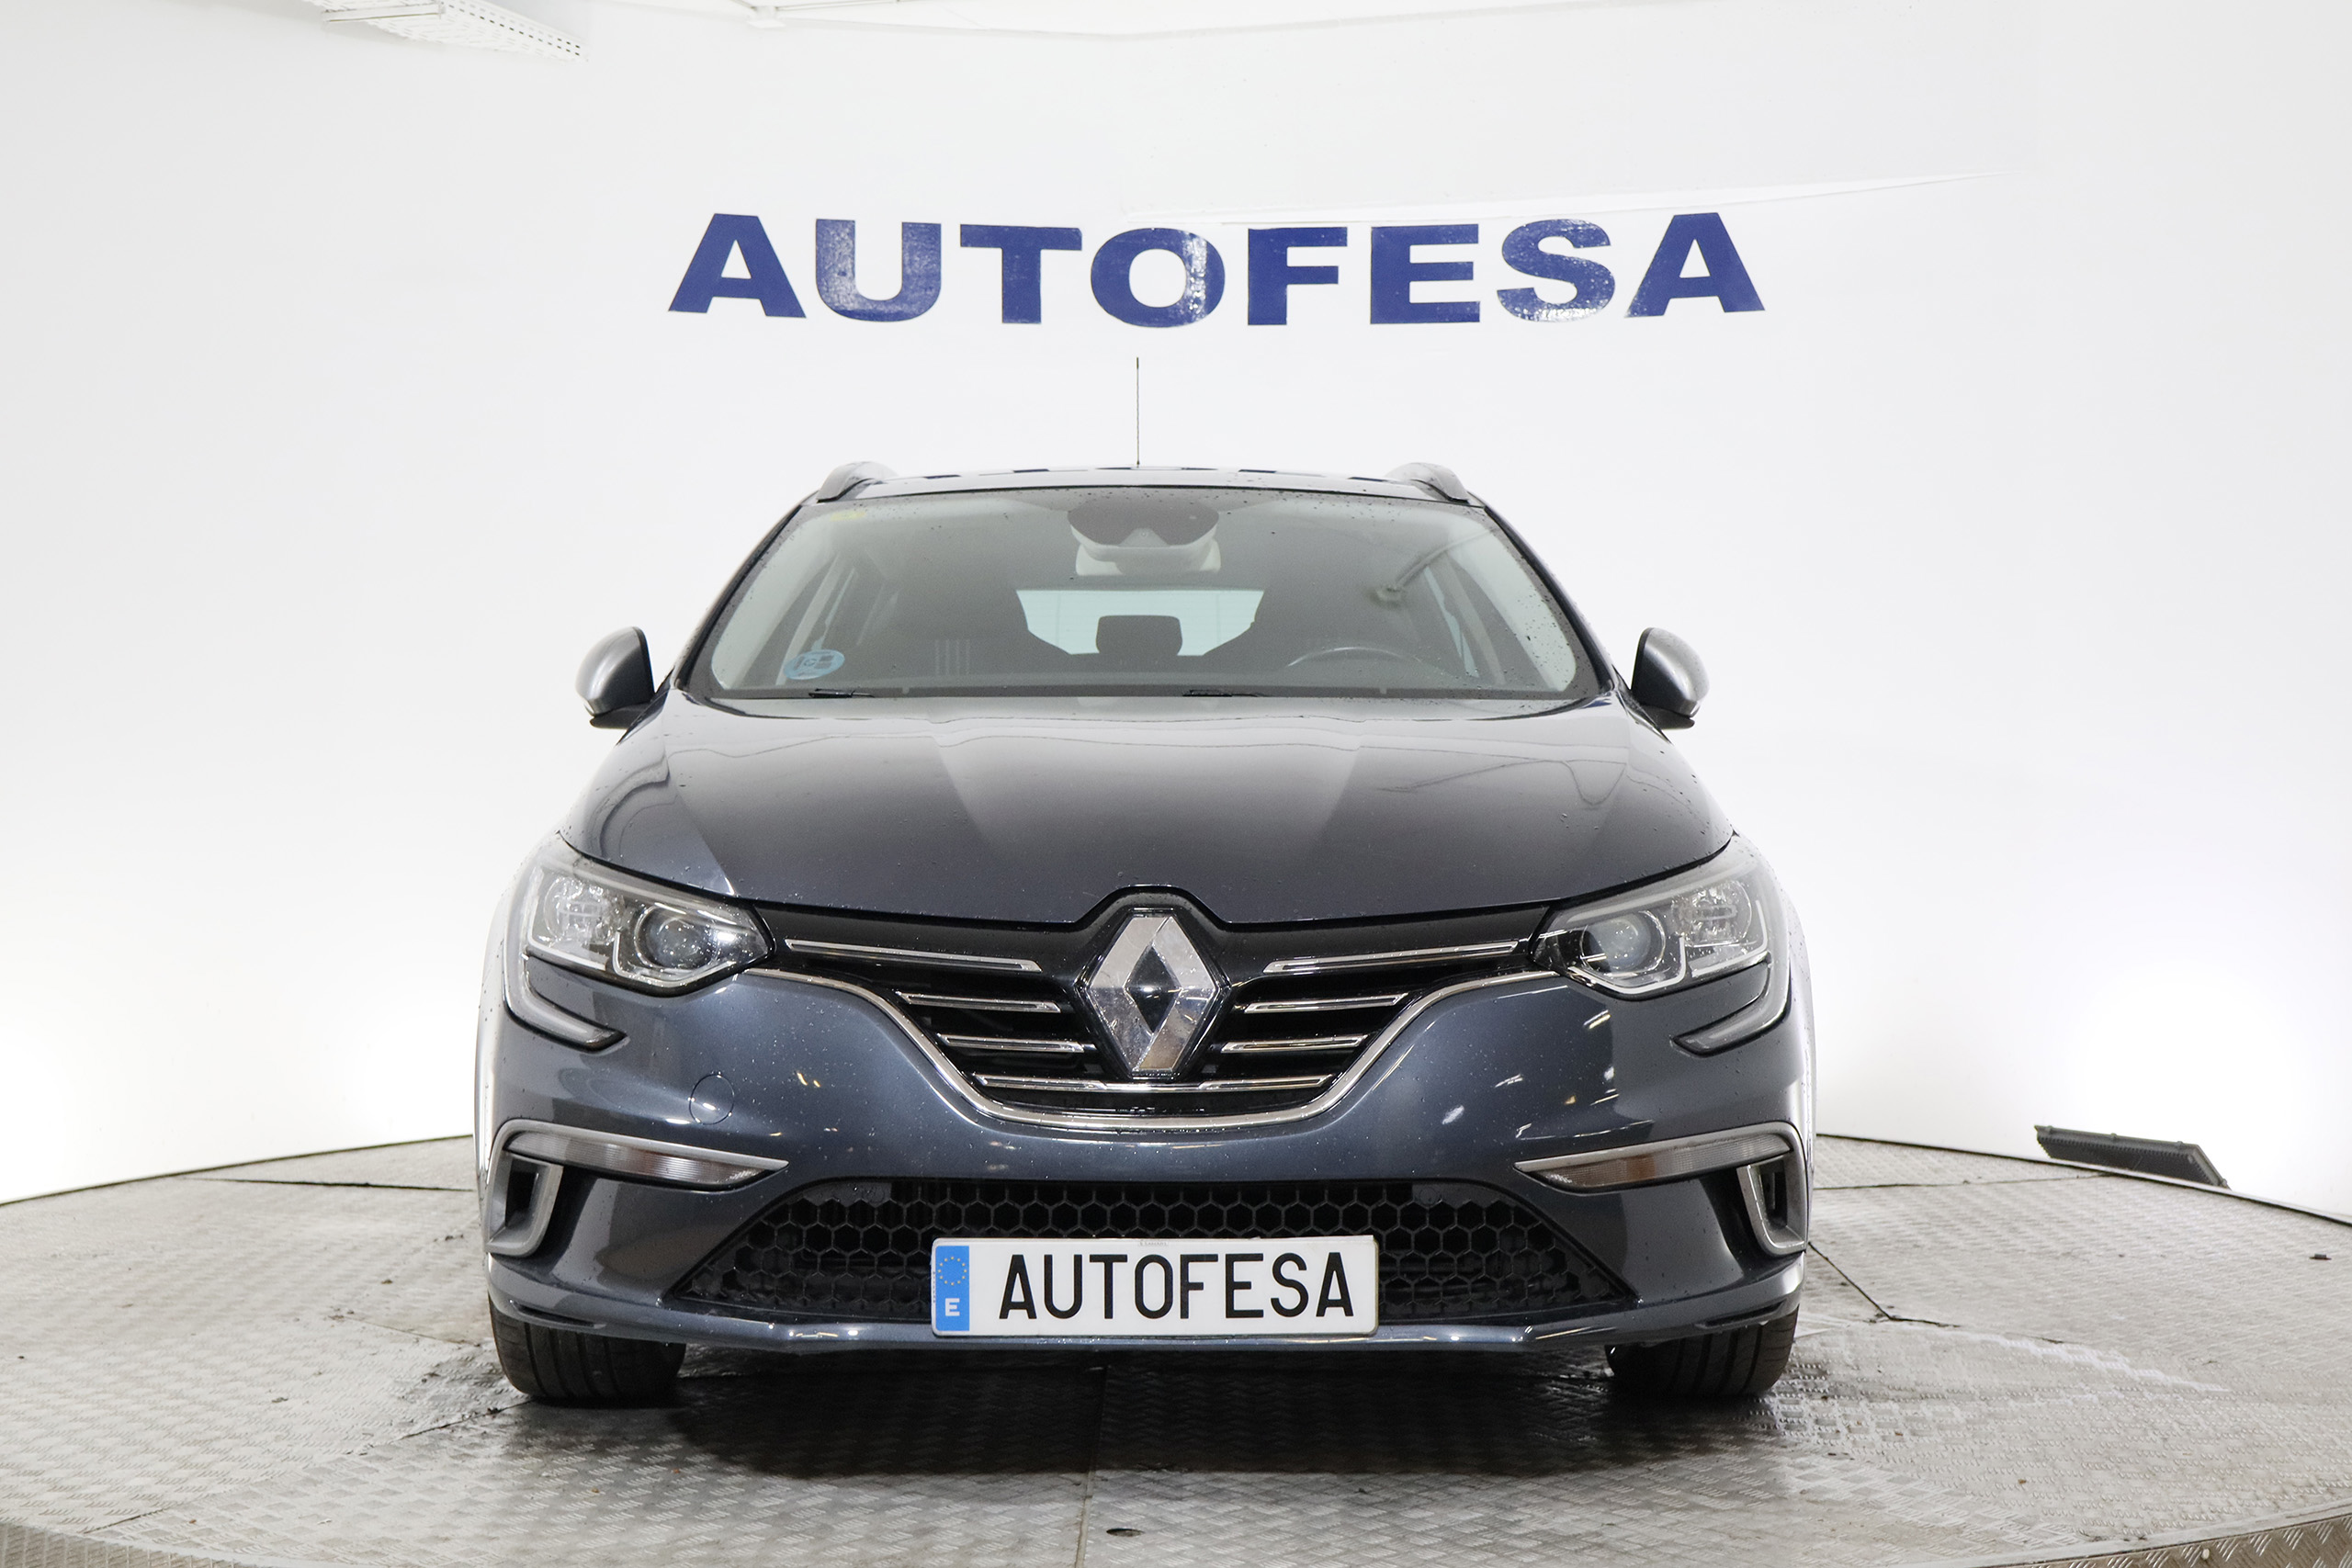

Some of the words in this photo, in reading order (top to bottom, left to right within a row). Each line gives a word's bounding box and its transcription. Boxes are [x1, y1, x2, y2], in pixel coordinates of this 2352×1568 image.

[669, 212, 1765, 327] AUTOFESA
[944, 1297, 961, 1316] E
[999, 1252, 1354, 1319] AUTOFESA
